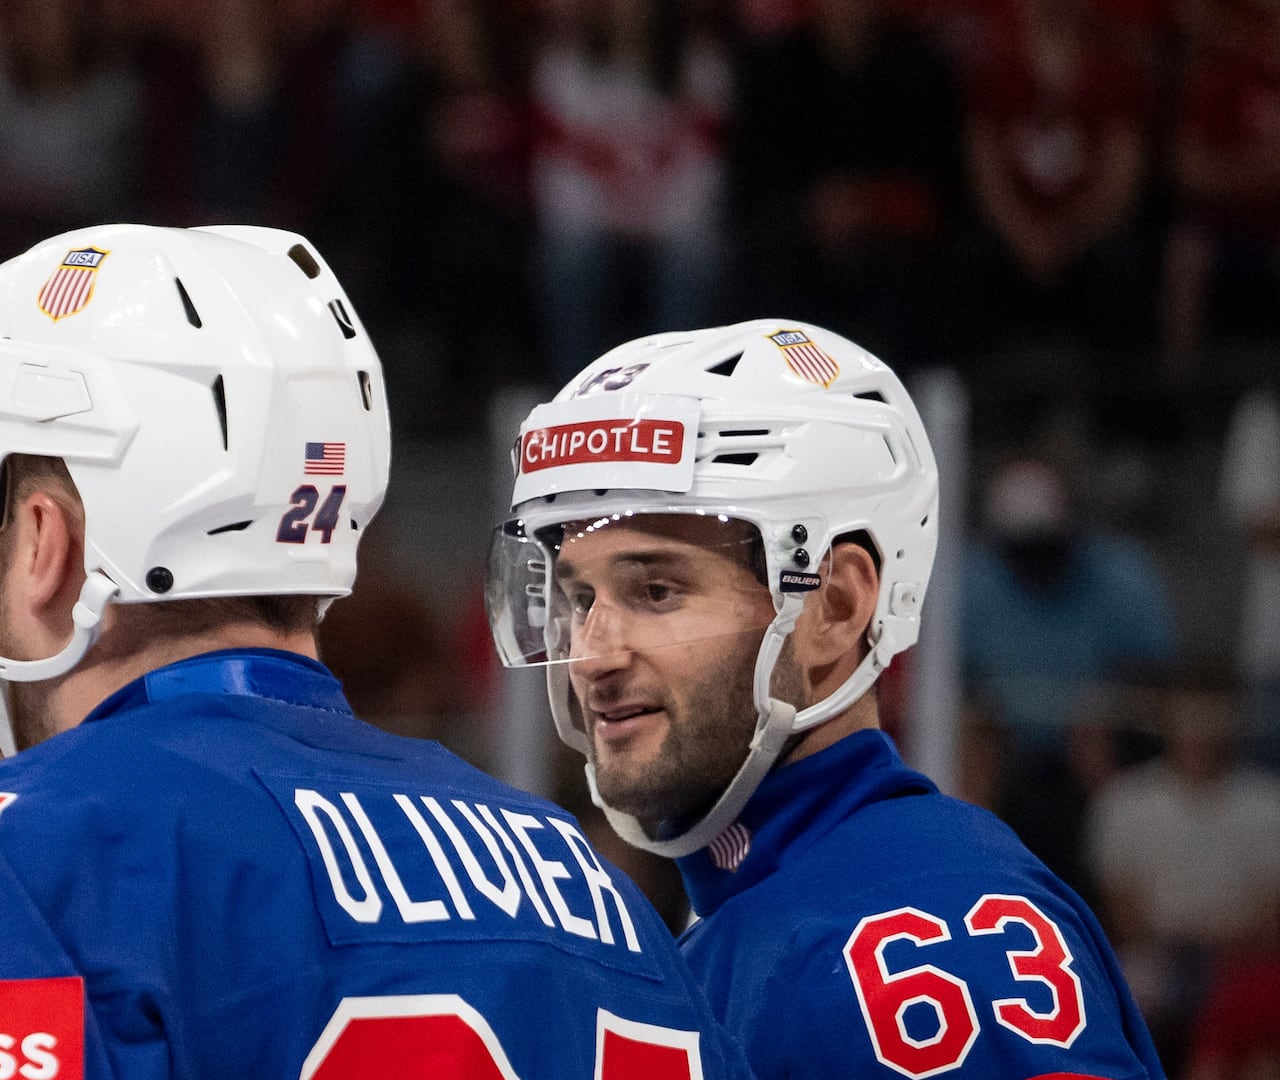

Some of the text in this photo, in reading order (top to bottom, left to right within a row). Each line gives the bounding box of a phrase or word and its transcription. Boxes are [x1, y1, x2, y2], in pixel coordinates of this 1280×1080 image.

[68, 253, 96, 265] USA
[776, 333, 806, 344] USA
[525, 427, 674, 464] CHIPOTLE
[275, 484, 347, 544] 24
[294, 788, 642, 953] OLIVIER
[842, 893, 1087, 1080] 63
